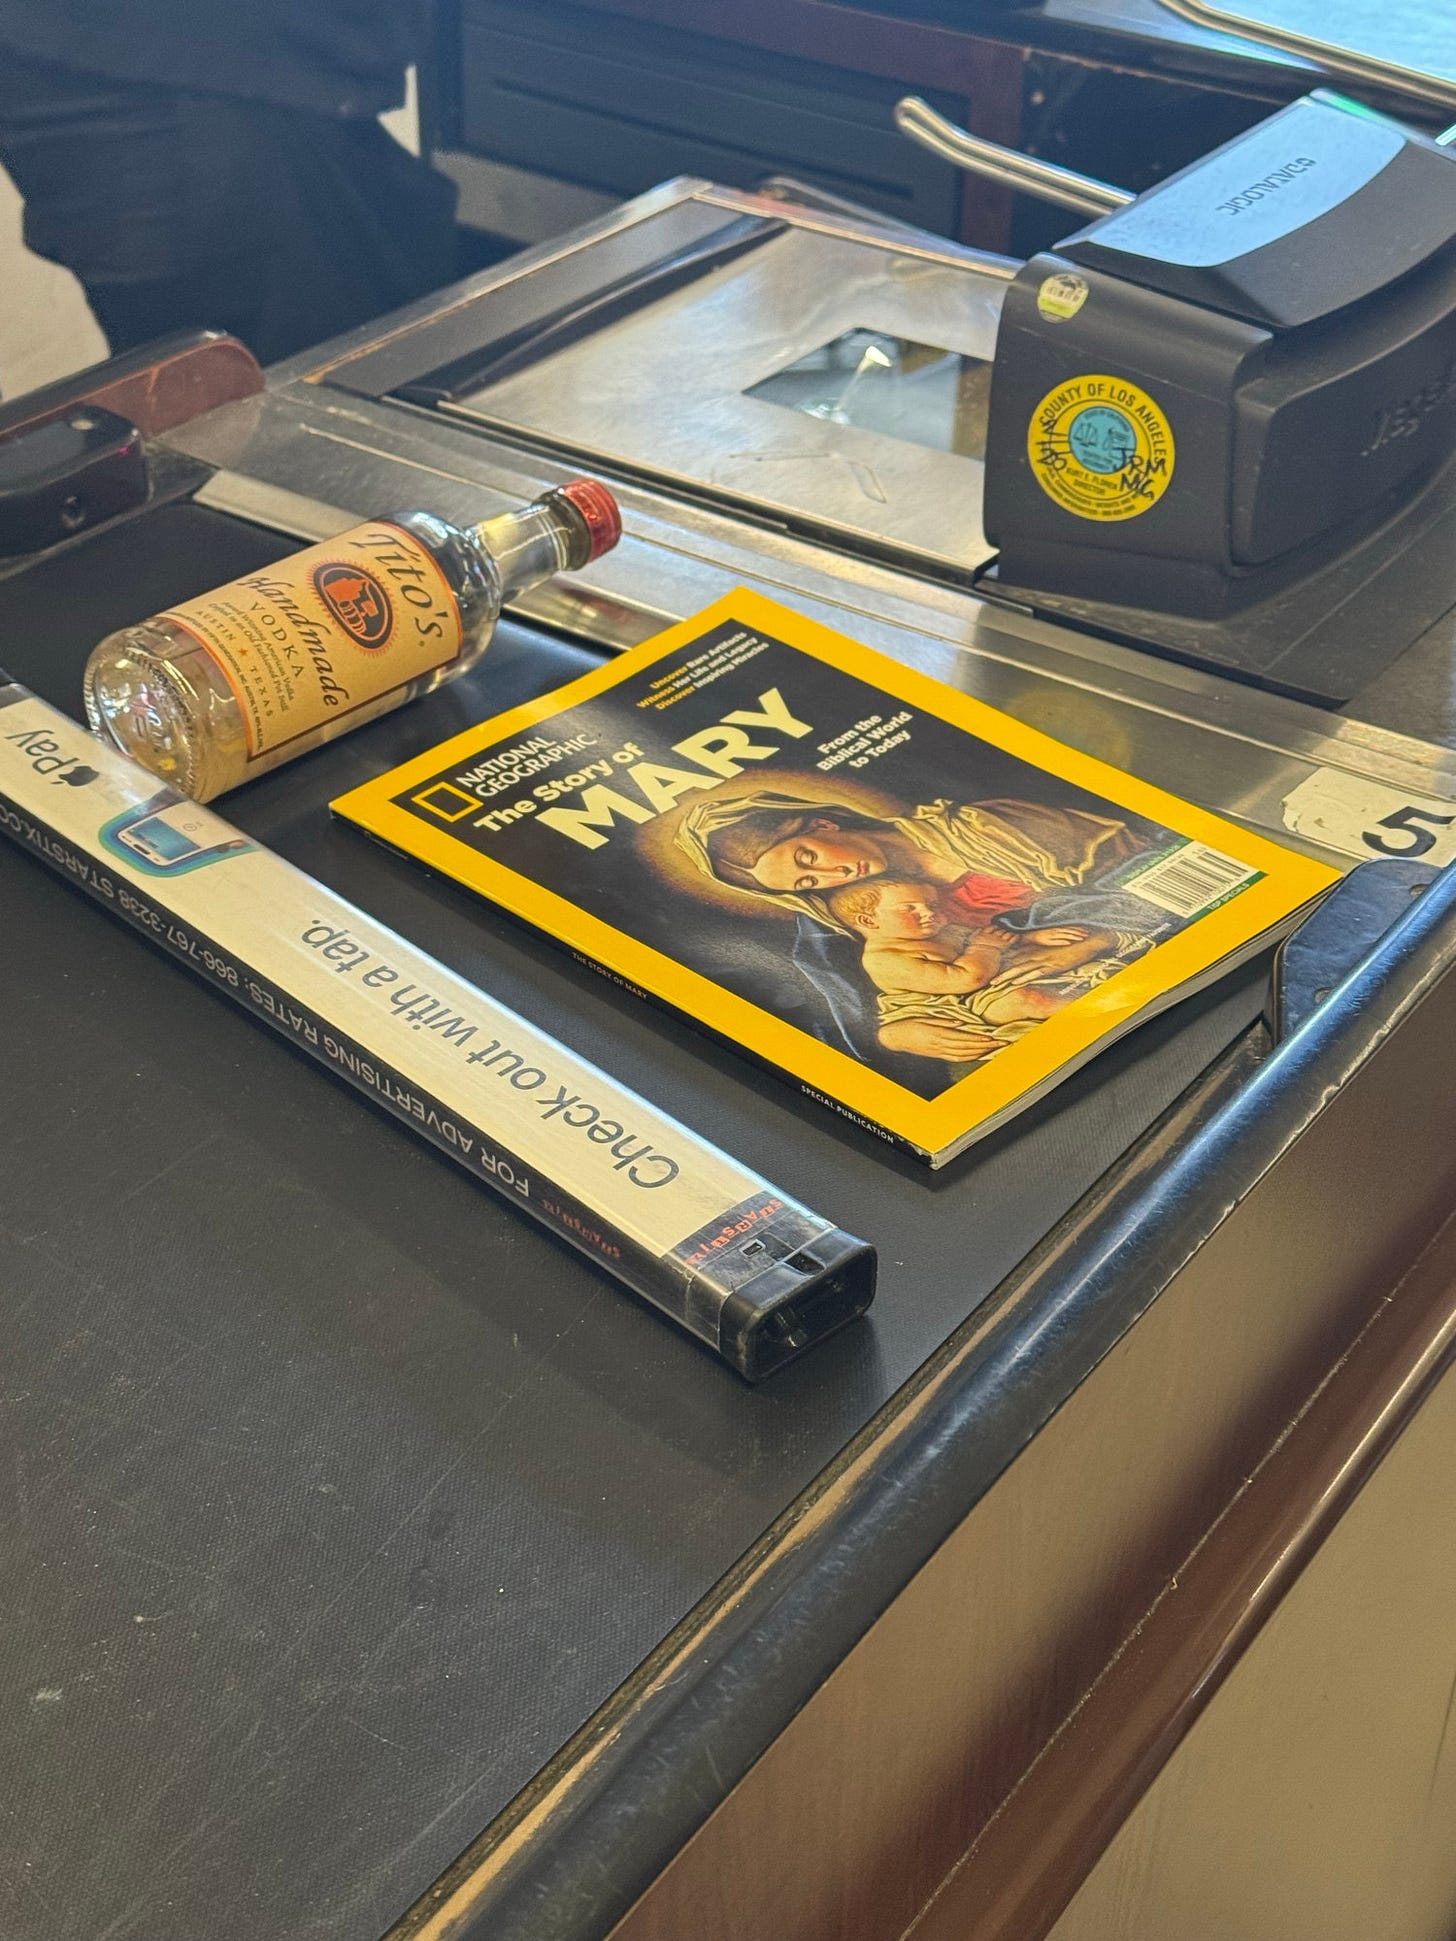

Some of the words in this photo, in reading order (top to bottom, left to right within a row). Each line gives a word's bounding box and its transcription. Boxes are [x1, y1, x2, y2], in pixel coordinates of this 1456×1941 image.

[1215, 163, 1308, 216] DATALOGIC
[1040, 385, 1081, 425] COUNTY
[1087, 383, 1104, 397] OF
[1109, 385, 1136, 407] LOS
[1134, 404, 1167, 463] ANGELES
[350, 533, 448, 638] Tito's
[196, 610, 236, 641] AUSTIN
[250, 665, 273, 717] TEXAS
[237, 576, 349, 707] Handmade
[251, 602, 304, 677] VODKA
[649, 665, 689, 689] Uncover
[686, 653, 710, 669] Rare
[708, 631, 748, 656] Artifacts
[636, 685, 676, 709] Witness
[674, 675, 692, 689] Her
[691, 665, 710, 678] Life
[708, 654, 728, 669] and
[725, 636, 759, 660] Legacy
[655, 686, 696, 710] Discover
[693, 663, 736, 689] Inspiring
[731, 641, 770, 665] Miracles
[5, 729, 79, 776] Pay
[456, 736, 558, 789] NATIONAL
[475, 732, 598, 798] GEOGRAPHIC
[815, 741, 864, 772] Biblical
[864, 711, 913, 744] World
[817, 731, 855, 755] From
[855, 714, 883, 736] the
[849, 753, 868, 768] to
[864, 730, 912, 760] Today
[473, 797, 537, 833] The
[532, 757, 620, 806] Story
[612, 741, 645, 768] of
[535, 687, 813, 850] MARY
[1361, 805, 1456, 858] 5
[119, 891, 239, 987] 866-767-3238
[302, 919, 369, 973] tap.
[364, 966, 401, 990] a
[572, 952, 587, 963] THE
[588, 961, 613, 979] STORY
[613, 976, 625, 987] OF
[625, 983, 648, 999] MARY
[245, 975, 319, 1045] RATES:
[390, 983, 478, 1046] with
[325, 1030, 474, 1154] ADVERTISING
[469, 1039, 548, 1091] out
[537, 1085, 680, 1190] Check
[800, 1085, 835, 1110] SPECIAL
[837, 1105, 895, 1143] PUBLICATION
[481, 1147, 530, 1198] FOR
